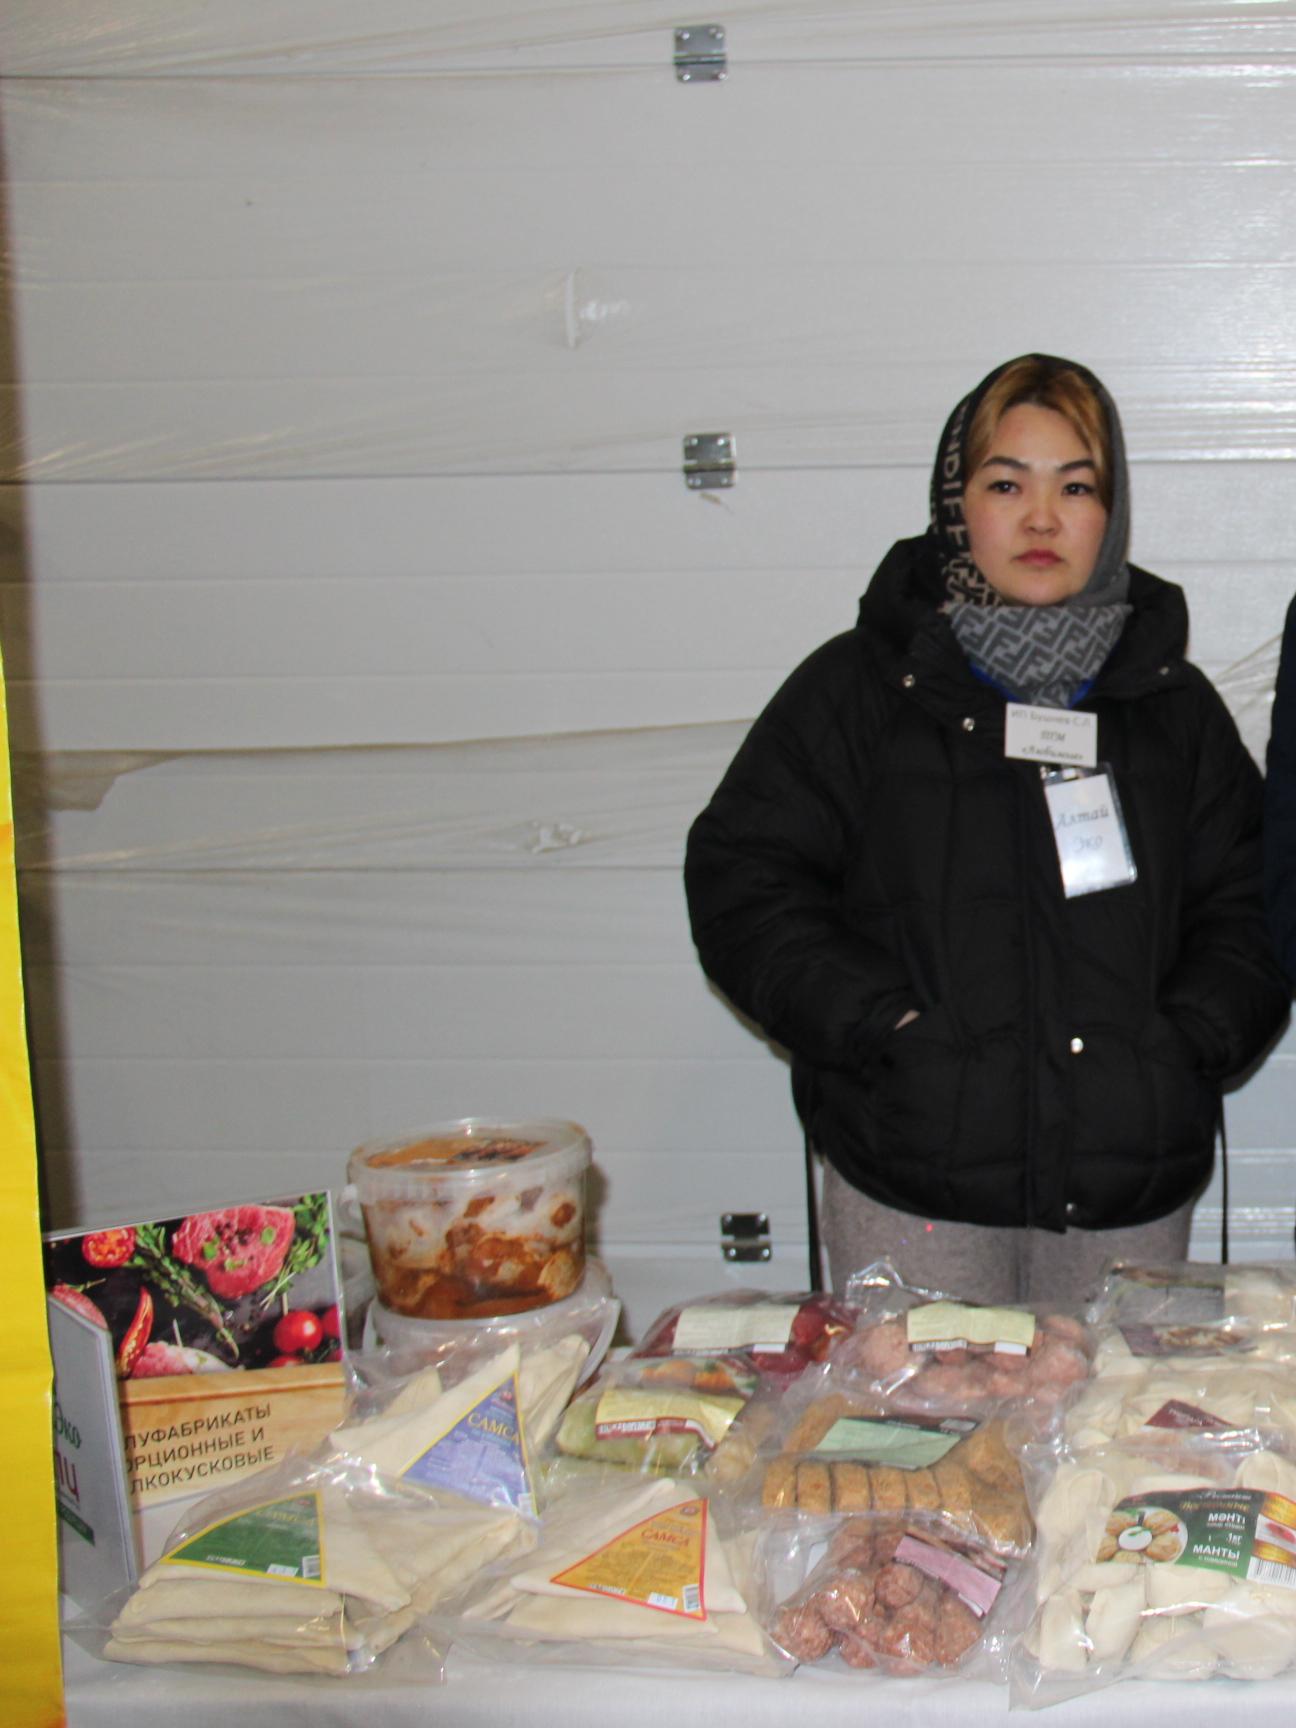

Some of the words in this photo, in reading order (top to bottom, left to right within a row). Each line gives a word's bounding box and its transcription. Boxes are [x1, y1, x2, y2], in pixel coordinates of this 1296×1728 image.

[252, 1426, 265, 1443] И
[641, 1527, 691, 1548] САМСА
[1192, 1543, 1241, 1561] МАНТЫ
